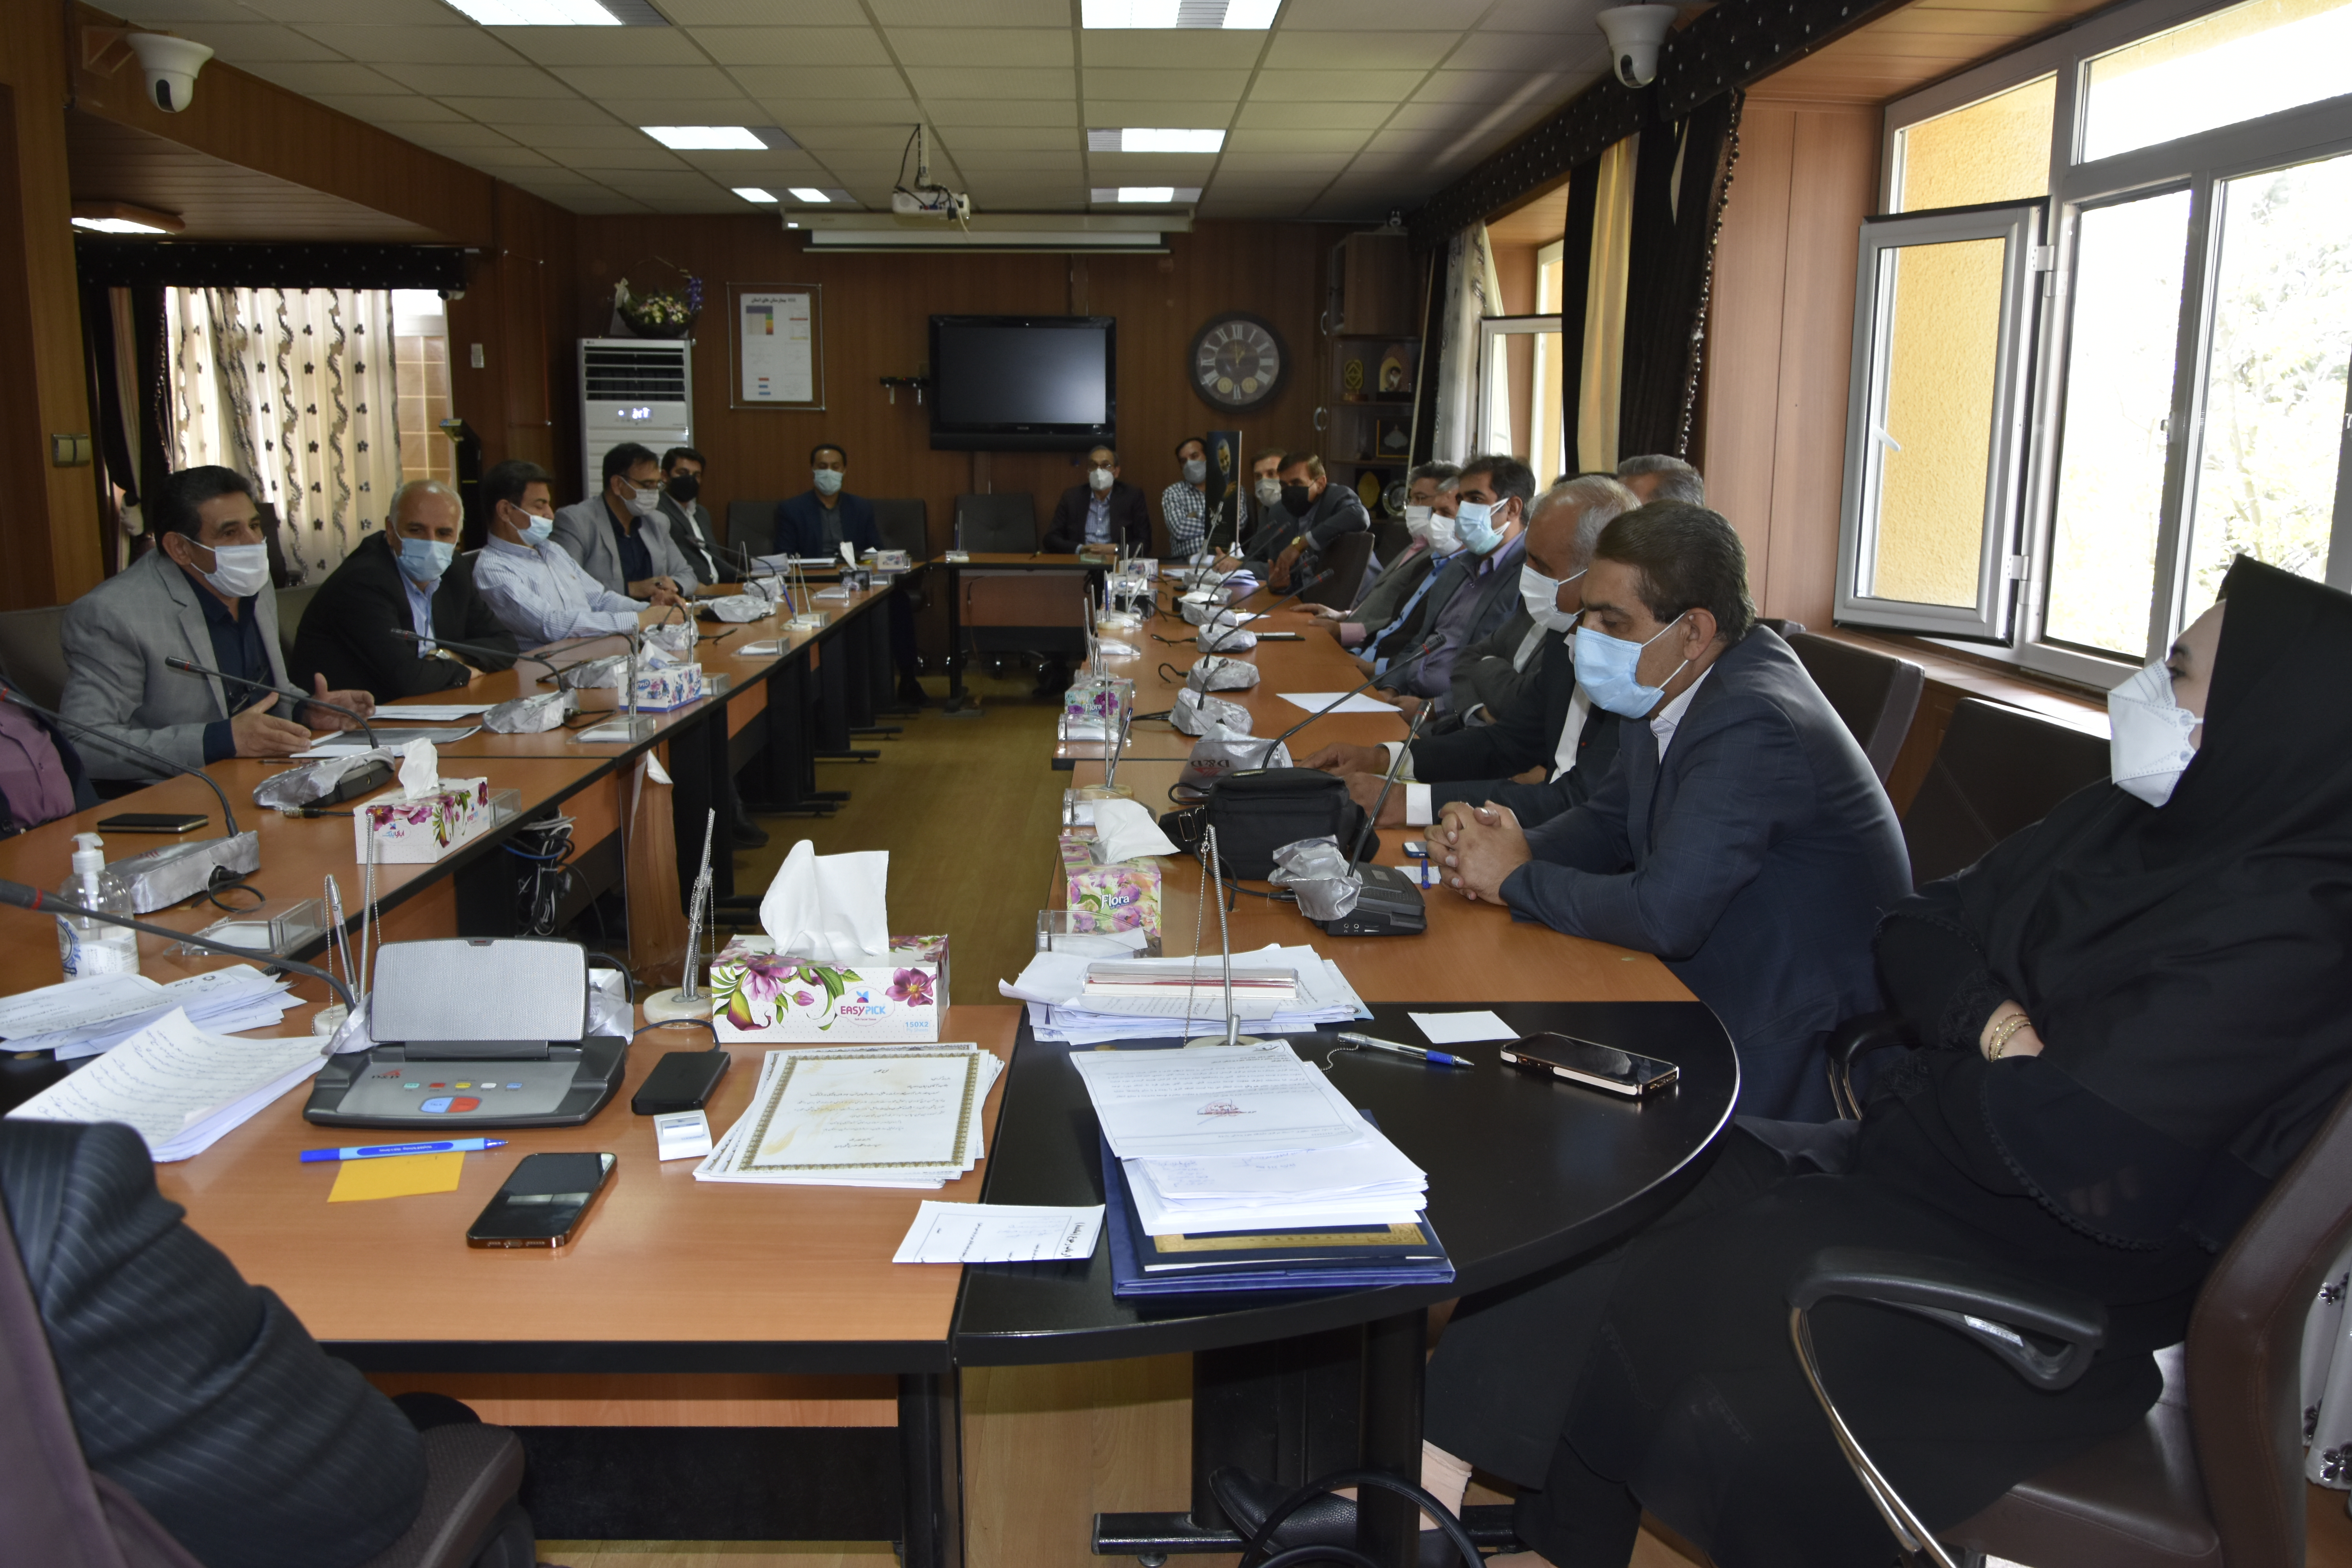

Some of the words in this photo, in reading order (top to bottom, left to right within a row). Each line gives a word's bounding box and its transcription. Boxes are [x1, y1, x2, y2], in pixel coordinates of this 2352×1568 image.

[1085, 703, 1102, 713] Flora
[1190, 759, 1230, 768] D&D
[1101, 893, 1130, 909] Flora
[840, 1005, 886, 1016] EASYPICK
